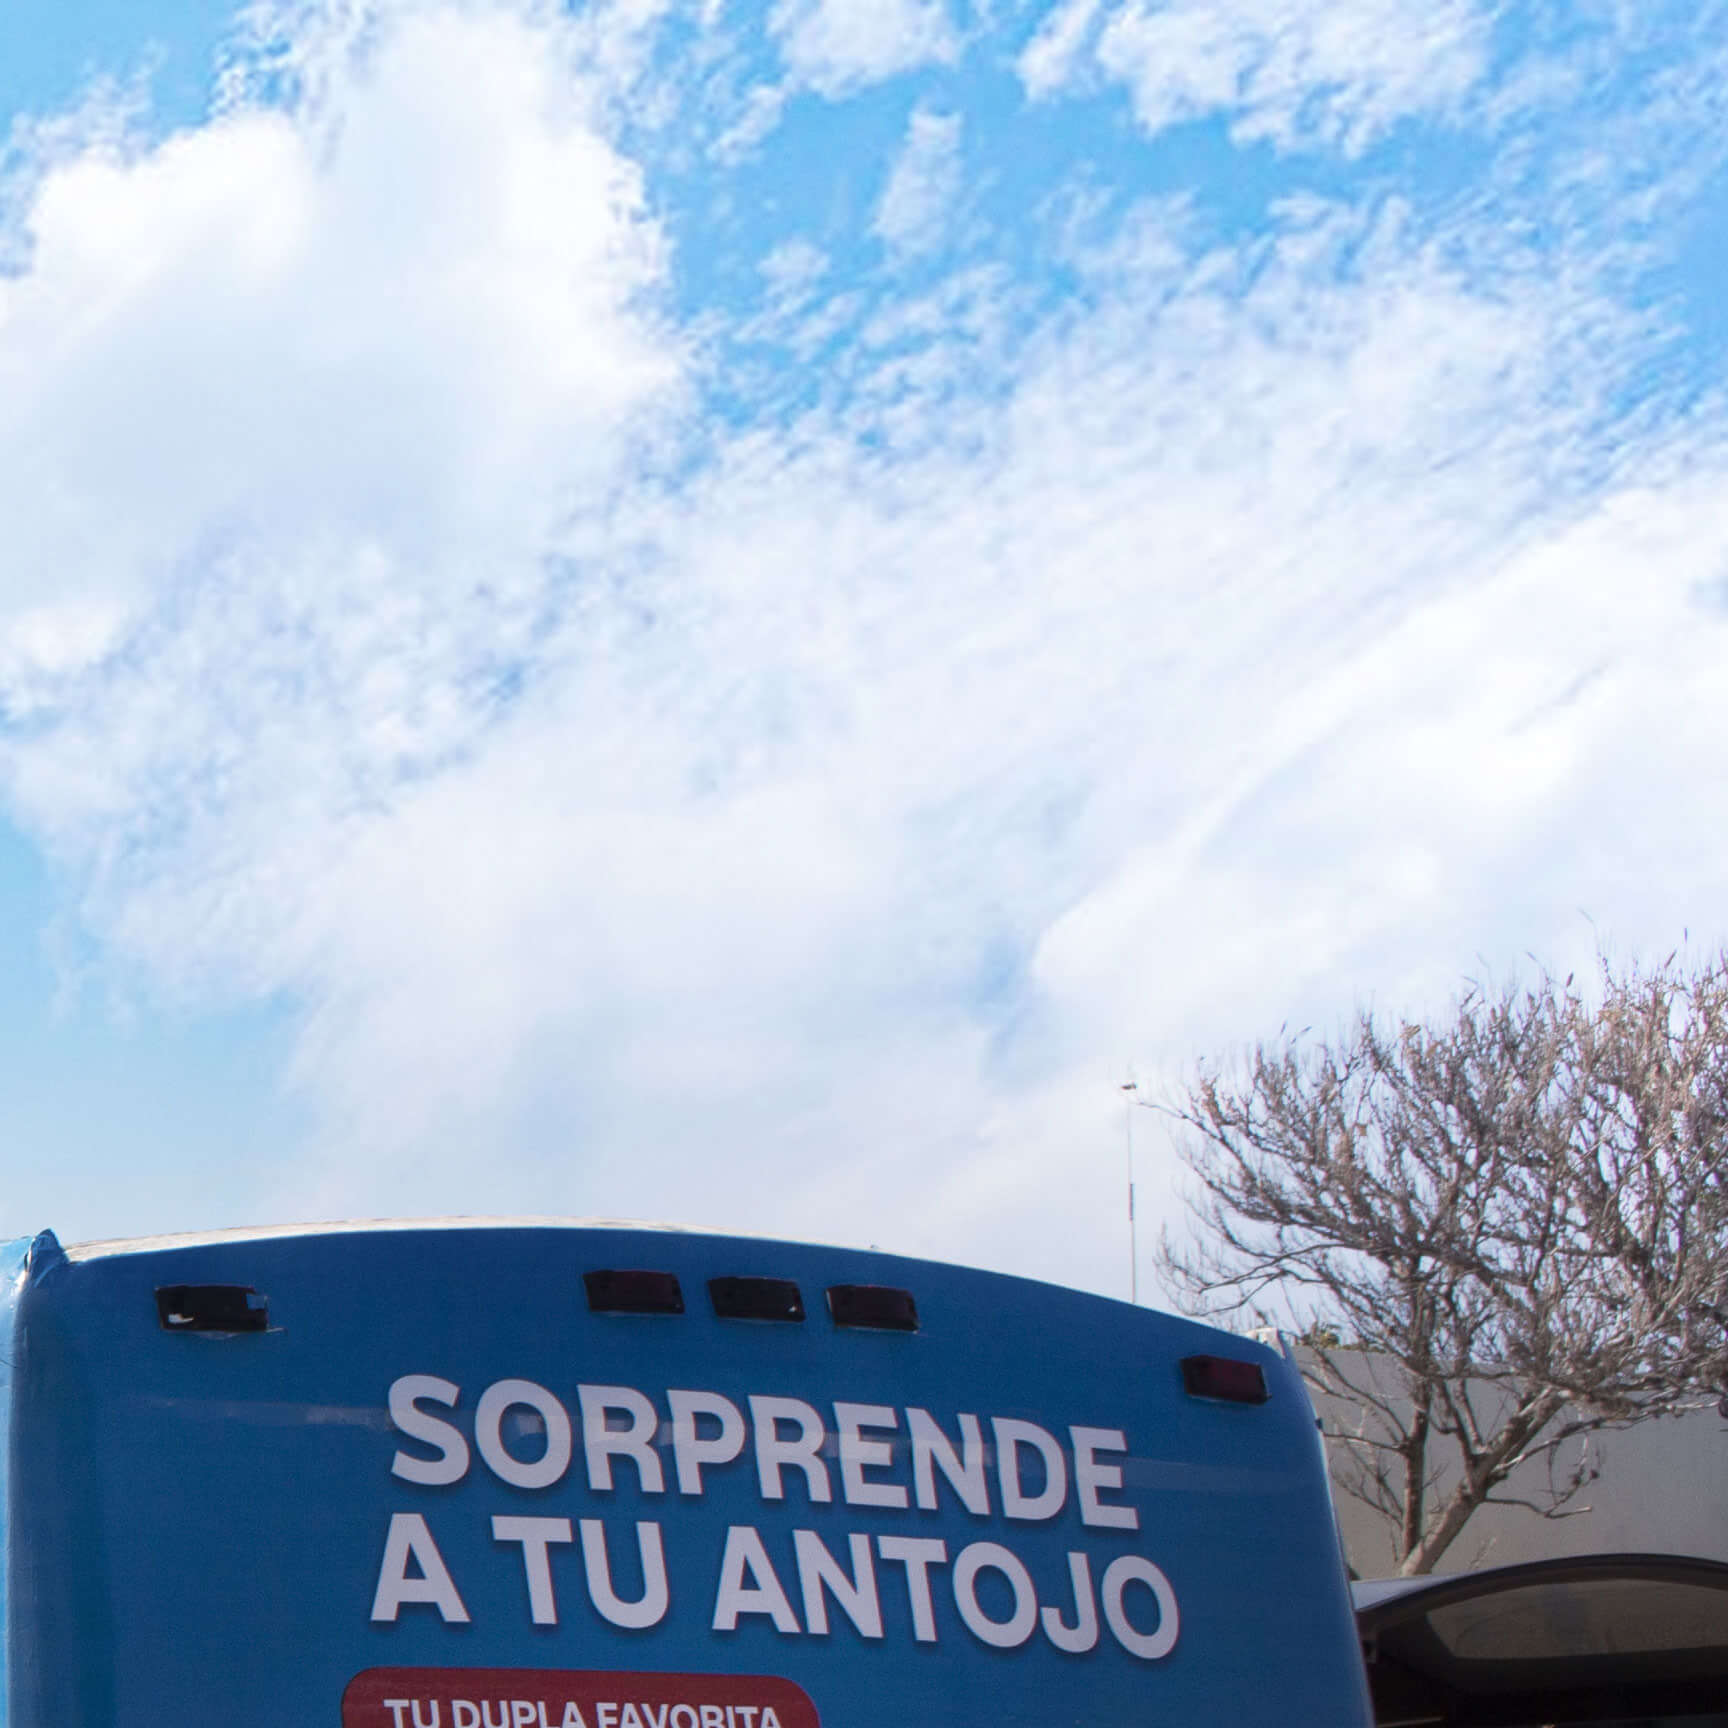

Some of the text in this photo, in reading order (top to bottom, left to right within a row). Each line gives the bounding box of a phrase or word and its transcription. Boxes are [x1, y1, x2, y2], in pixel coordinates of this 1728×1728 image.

[386, 1373, 1140, 1530] SORPRENDE
[369, 1512, 1181, 1660] A TU ANTOJO
